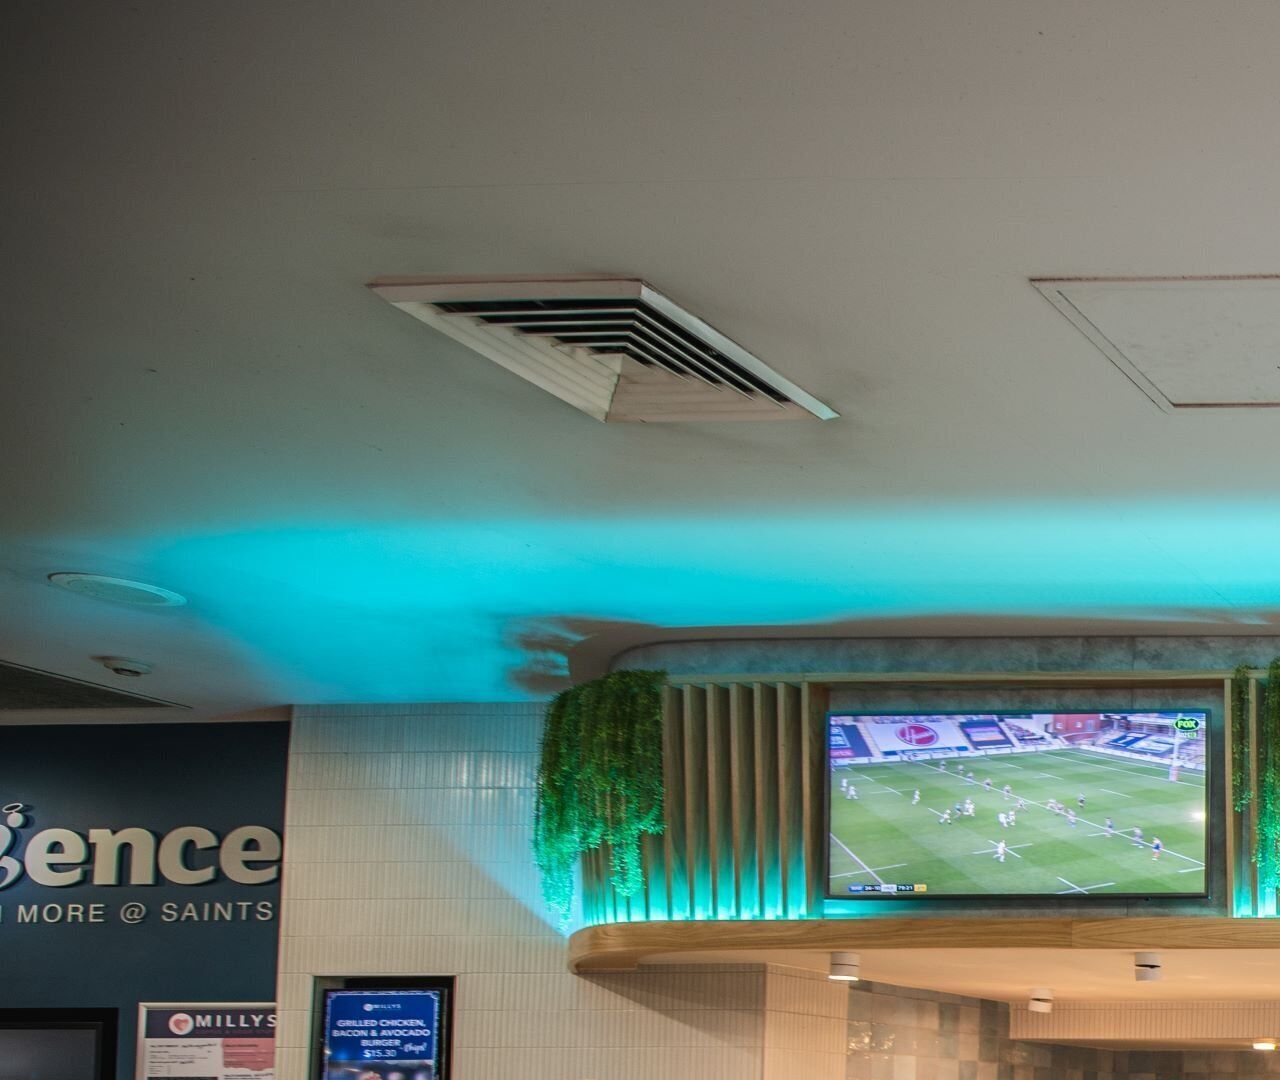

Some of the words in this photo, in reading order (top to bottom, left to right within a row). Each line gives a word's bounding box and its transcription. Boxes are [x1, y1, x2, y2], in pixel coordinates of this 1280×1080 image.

[1177, 720, 1196, 728] FOX
[17, 904, 105, 923] MORE
[120, 902, 147, 924] @
[161, 902, 274, 922] SAINTS
[195, 1014, 277, 1027] MILLYS
[336, 1019, 378, 1027] GRILLED
[379, 1019, 426, 1027] CHICKEN,
[331, 1029, 369, 1037] BACON
[379, 1028, 431, 1036] AVOCADO
[360, 1039, 401, 1047] BURGER
